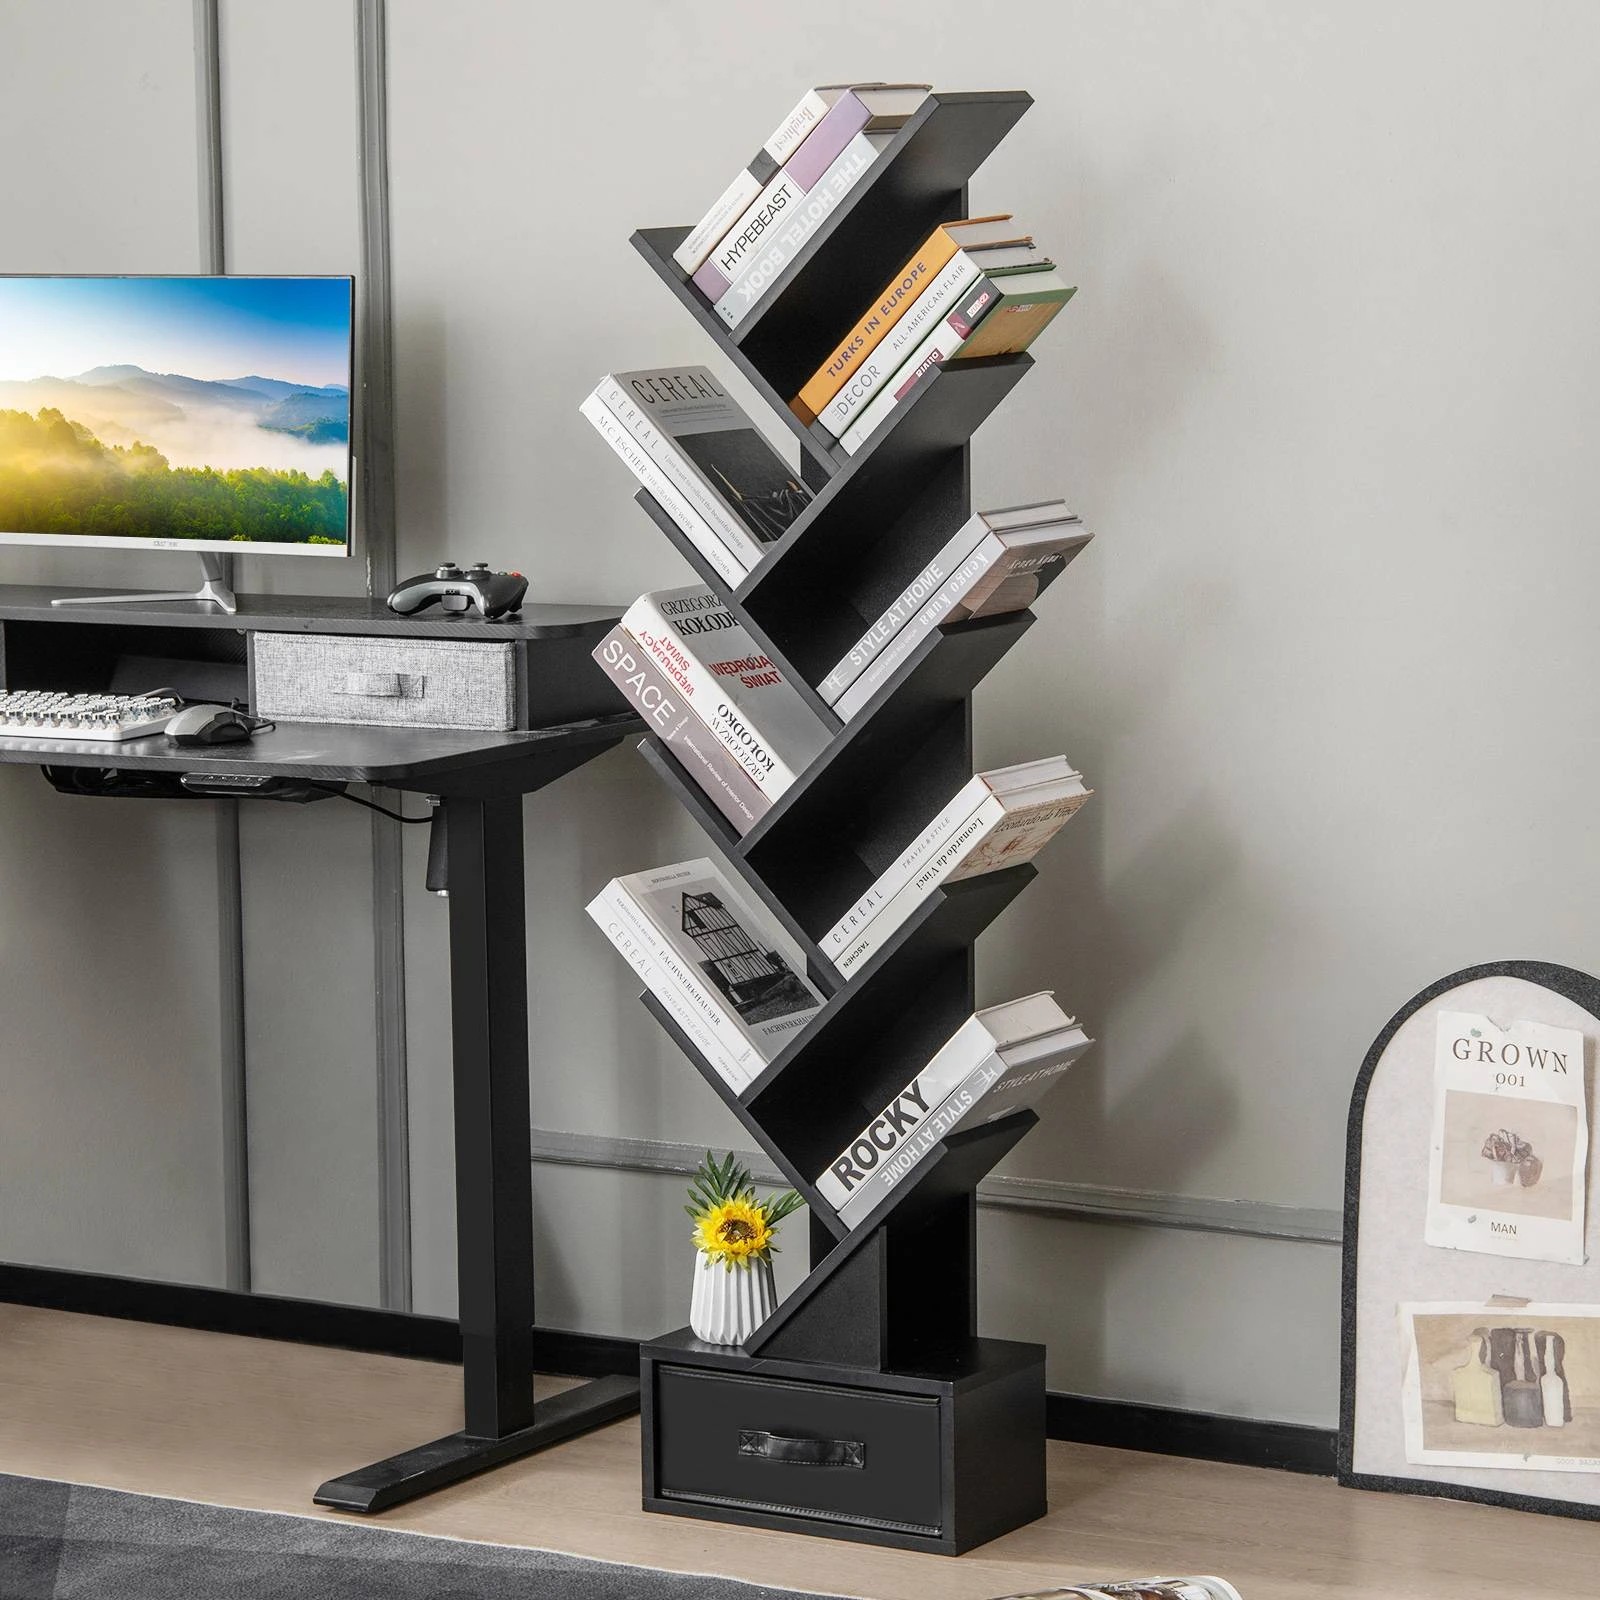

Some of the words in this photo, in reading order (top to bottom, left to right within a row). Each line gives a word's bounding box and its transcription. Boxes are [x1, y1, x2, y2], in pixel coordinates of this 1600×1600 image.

[774, 106, 815, 151] Brightest
[830, 152, 867, 196] THE
[720, 184, 792, 270] HYPEBEAST
[782, 187, 834, 247] HOTEL
[738, 247, 785, 302] BOOK
[826, 336, 864, 378] TURKS
[864, 316, 881, 334] IN
[881, 262, 927, 316] EUROPE
[892, 288, 944, 351] ALL-AMERICAN
[943, 264, 965, 292] FLAIR
[631, 374, 724, 404] CEREAL
[836, 364, 880, 416] DECOR
[608, 390, 658, 450] CEREAL
[615, 436, 648, 476] ESCHER
[950, 553, 990, 593] Kengo
[850, 625, 890, 666] STYLE
[888, 602, 909, 628] AT
[902, 563, 944, 616] HOME
[919, 592, 952, 625] Kuma
[639, 631, 696, 696] WĘDRUJĄCY
[658, 636, 691, 672] ŚWIAT
[602, 640, 676, 727] SPACE
[740, 671, 782, 688] ŚWIAT
[681, 734, 710, 765] International
[716, 704, 776, 773] KOŁODKO
[718, 726, 767, 783] GRZEGORZ
[705, 762, 724, 782] Review
[720, 779, 729, 787] of
[724, 785, 742, 804] Interior
[736, 801, 756, 821] Design
[902, 840, 926, 870] TRAVEL
[930, 816, 952, 840] STYLE
[946, 818, 984, 856] Leonardo
[916, 864, 940, 890] Vinci
[936, 854, 949, 867] da
[832, 889, 884, 944] CEREAL
[607, 922, 652, 977] CEREAL
[843, 940, 870, 968] TASCHEN
[1452, 1038, 1568, 1074] GROWN
[932, 1090, 973, 1134] STYLE
[830, 1079, 930, 1191] ROCKY
[921, 1130, 934, 1152] AT
[880, 1147, 922, 1187] HOME
[1490, 1221, 1518, 1236] MAN
